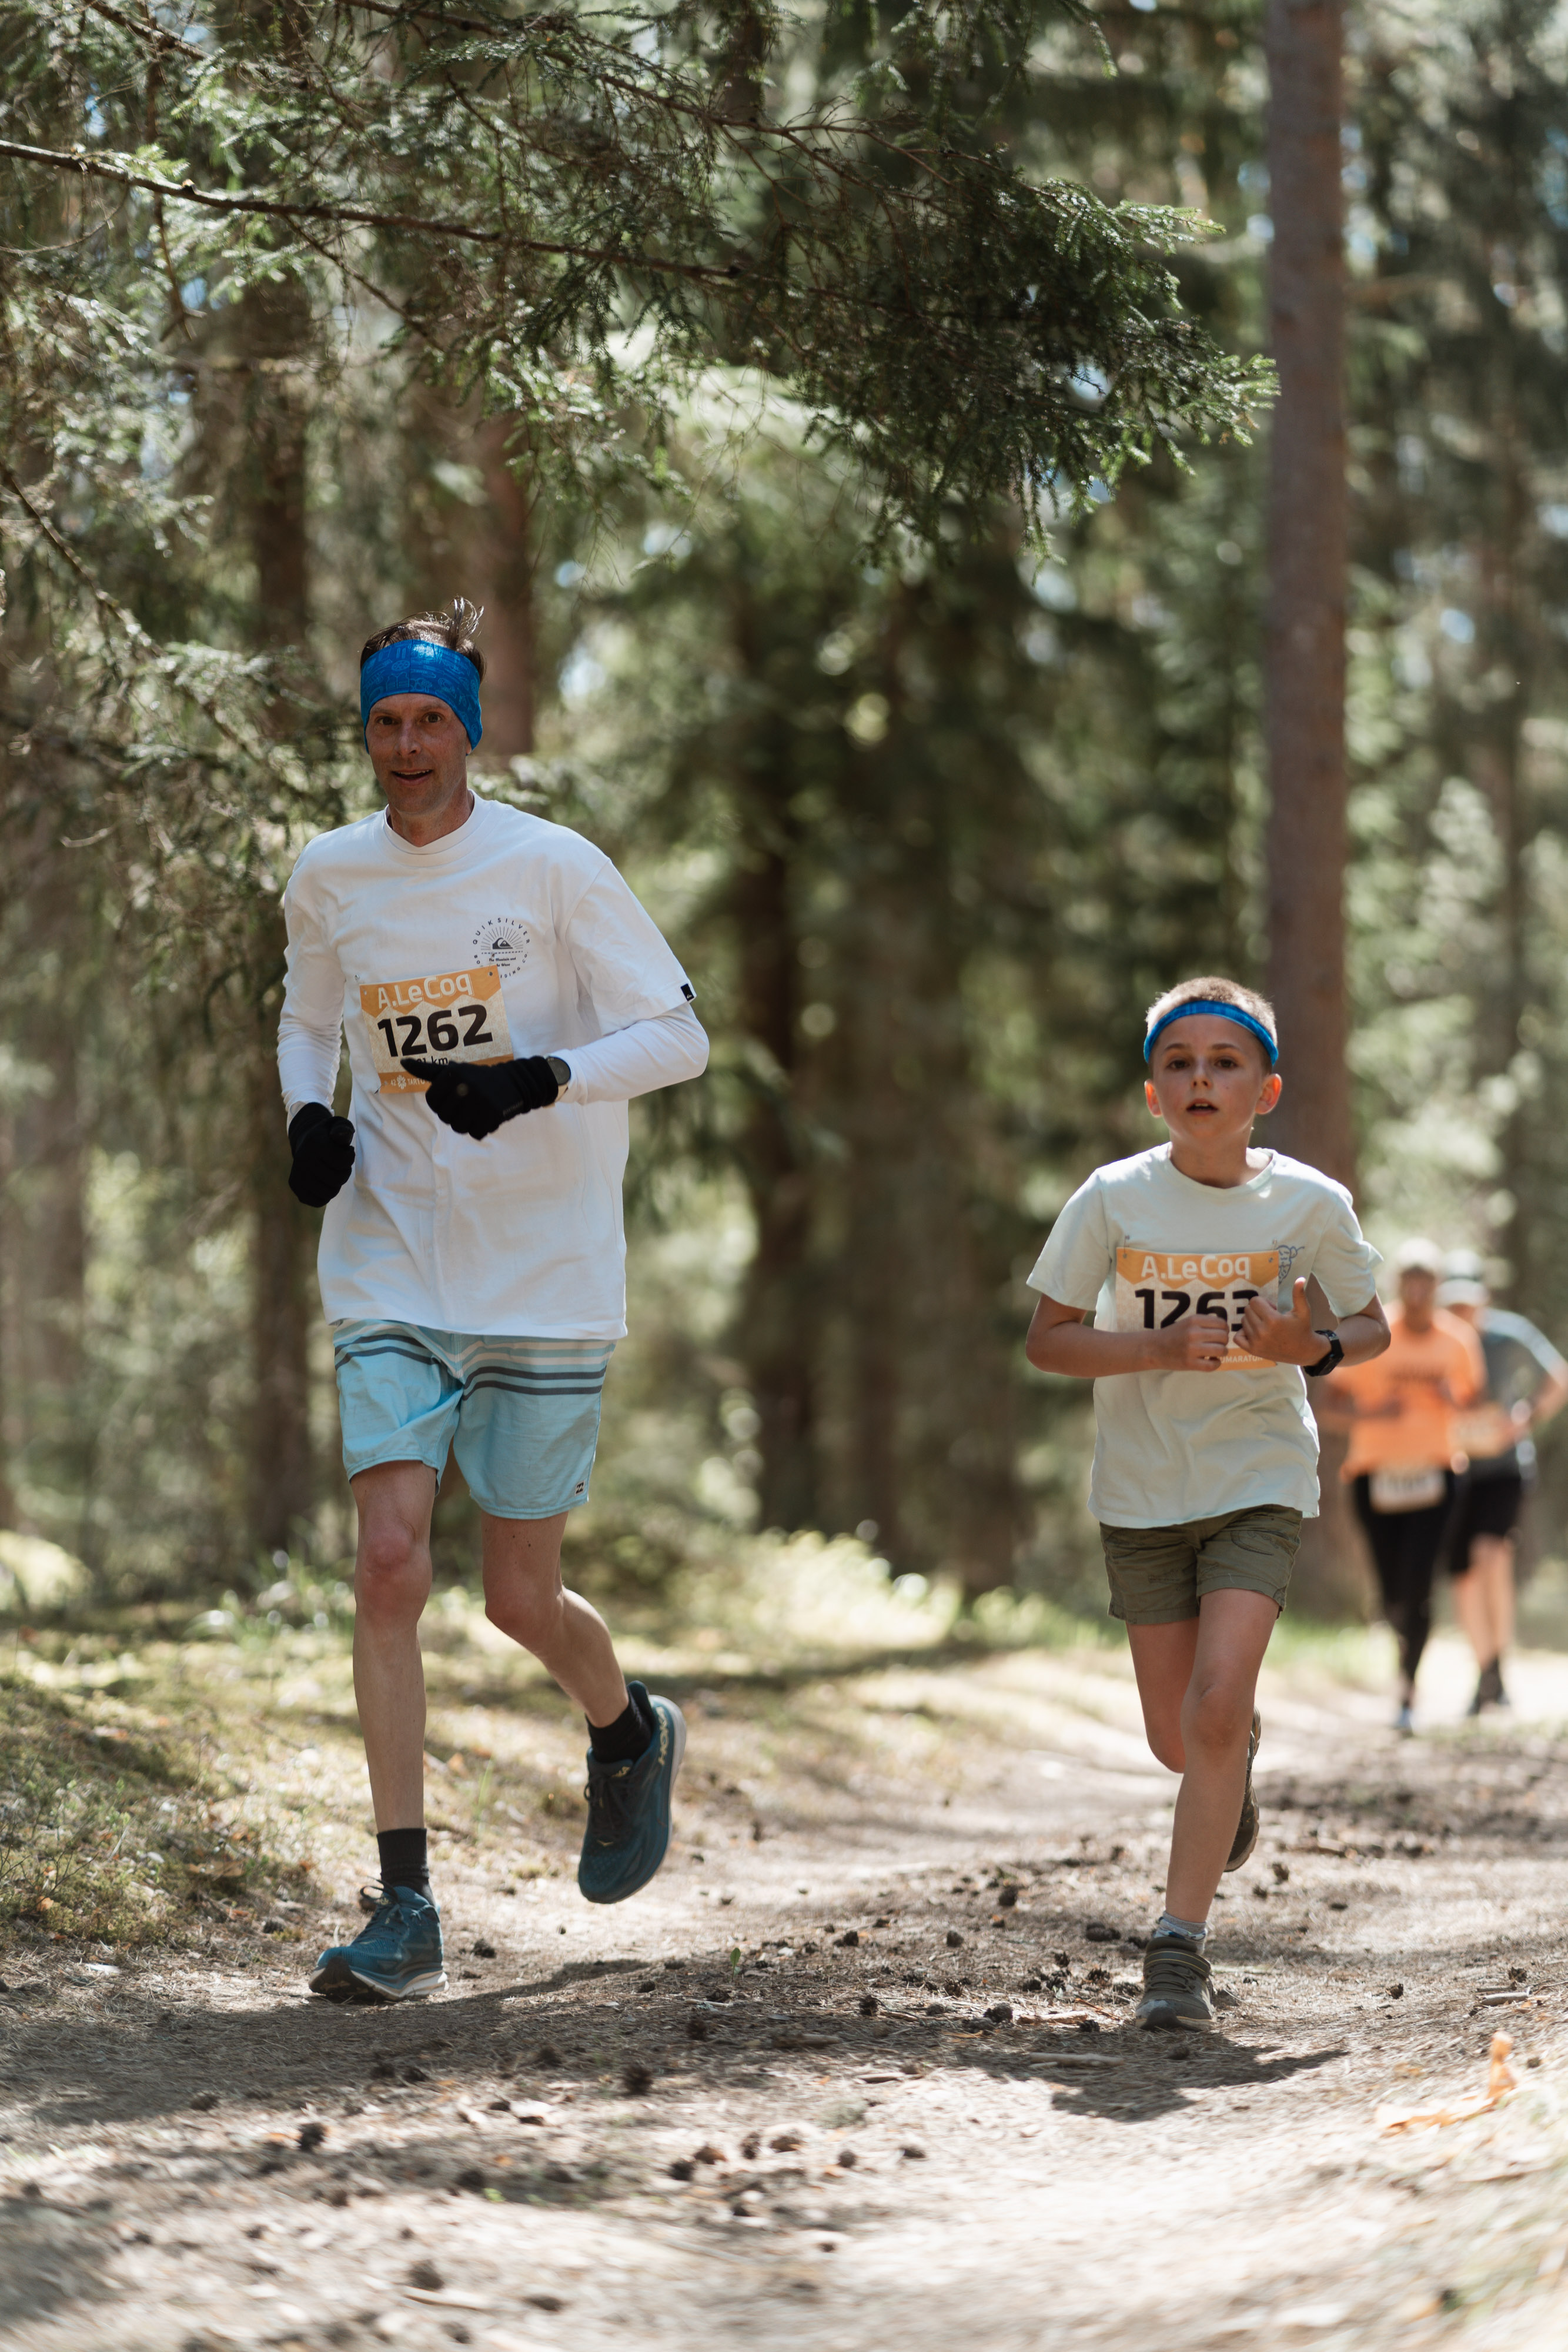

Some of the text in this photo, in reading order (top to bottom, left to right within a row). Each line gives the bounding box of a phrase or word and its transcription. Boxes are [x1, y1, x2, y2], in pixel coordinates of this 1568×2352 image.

[473, 917, 530, 944] QUIKSILVER
[377, 1004, 493, 1057] 1262
[407, 1077, 427, 1085] TARTU
